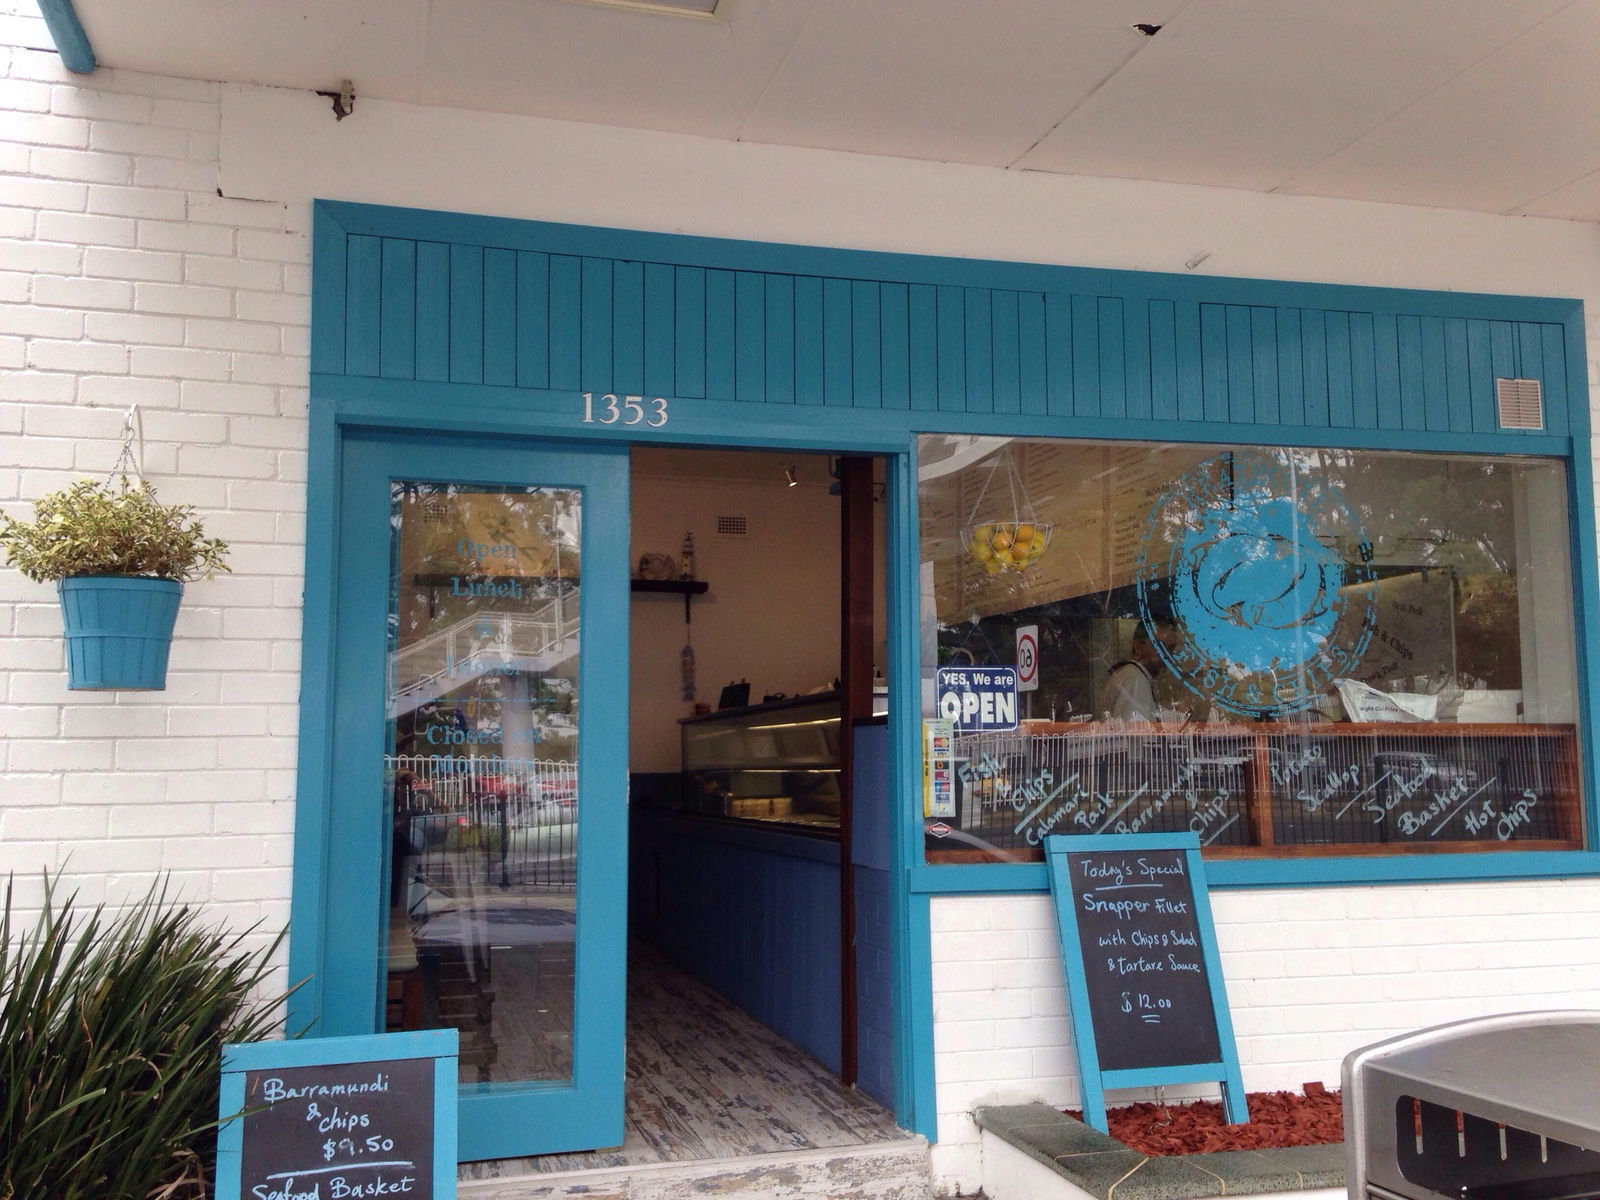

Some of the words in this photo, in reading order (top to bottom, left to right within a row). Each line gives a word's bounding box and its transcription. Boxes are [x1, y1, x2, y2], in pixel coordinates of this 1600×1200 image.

[582, 393, 668, 427] 1353
[457, 538, 517, 561] Open
[449, 577, 523, 598] Lunch
[942, 672, 970, 687] YES,
[973, 672, 991, 685] We
[994, 675, 1013, 685] are
[941, 691, 1015, 724] OPEN
[427, 725, 504, 745] Closed
[958, 752, 1007, 788] Fish
[1012, 768, 1054, 812] Chips
[1297, 764, 1359, 812] Scallop
[1362, 756, 1436, 823] Seafood
[1026, 783, 1089, 845] Calamari
[1074, 793, 1114, 828] Pack
[1190, 788, 1230, 835] Chips
[1398, 776, 1468, 835] Basket
[1464, 800, 1497, 836] Hot
[1081, 860, 1132, 885] Today's
[1138, 858, 1184, 880] Special
[1083, 893, 1150, 920] Snapper
[1155, 898, 1187, 914] Fillet
[1099, 929, 1127, 947] with
[1131, 930, 1160, 949] Chips
[1170, 930, 1197, 946] Salad
[1108, 958, 1116, 972] &
[1168, 953, 1201, 973] Sauce
[263, 1073, 389, 1106] Barramundi
[306, 1103, 322, 1121] &
[323, 1135, 394, 1161] $9.50
[330, 1176, 416, 1199] Basket
